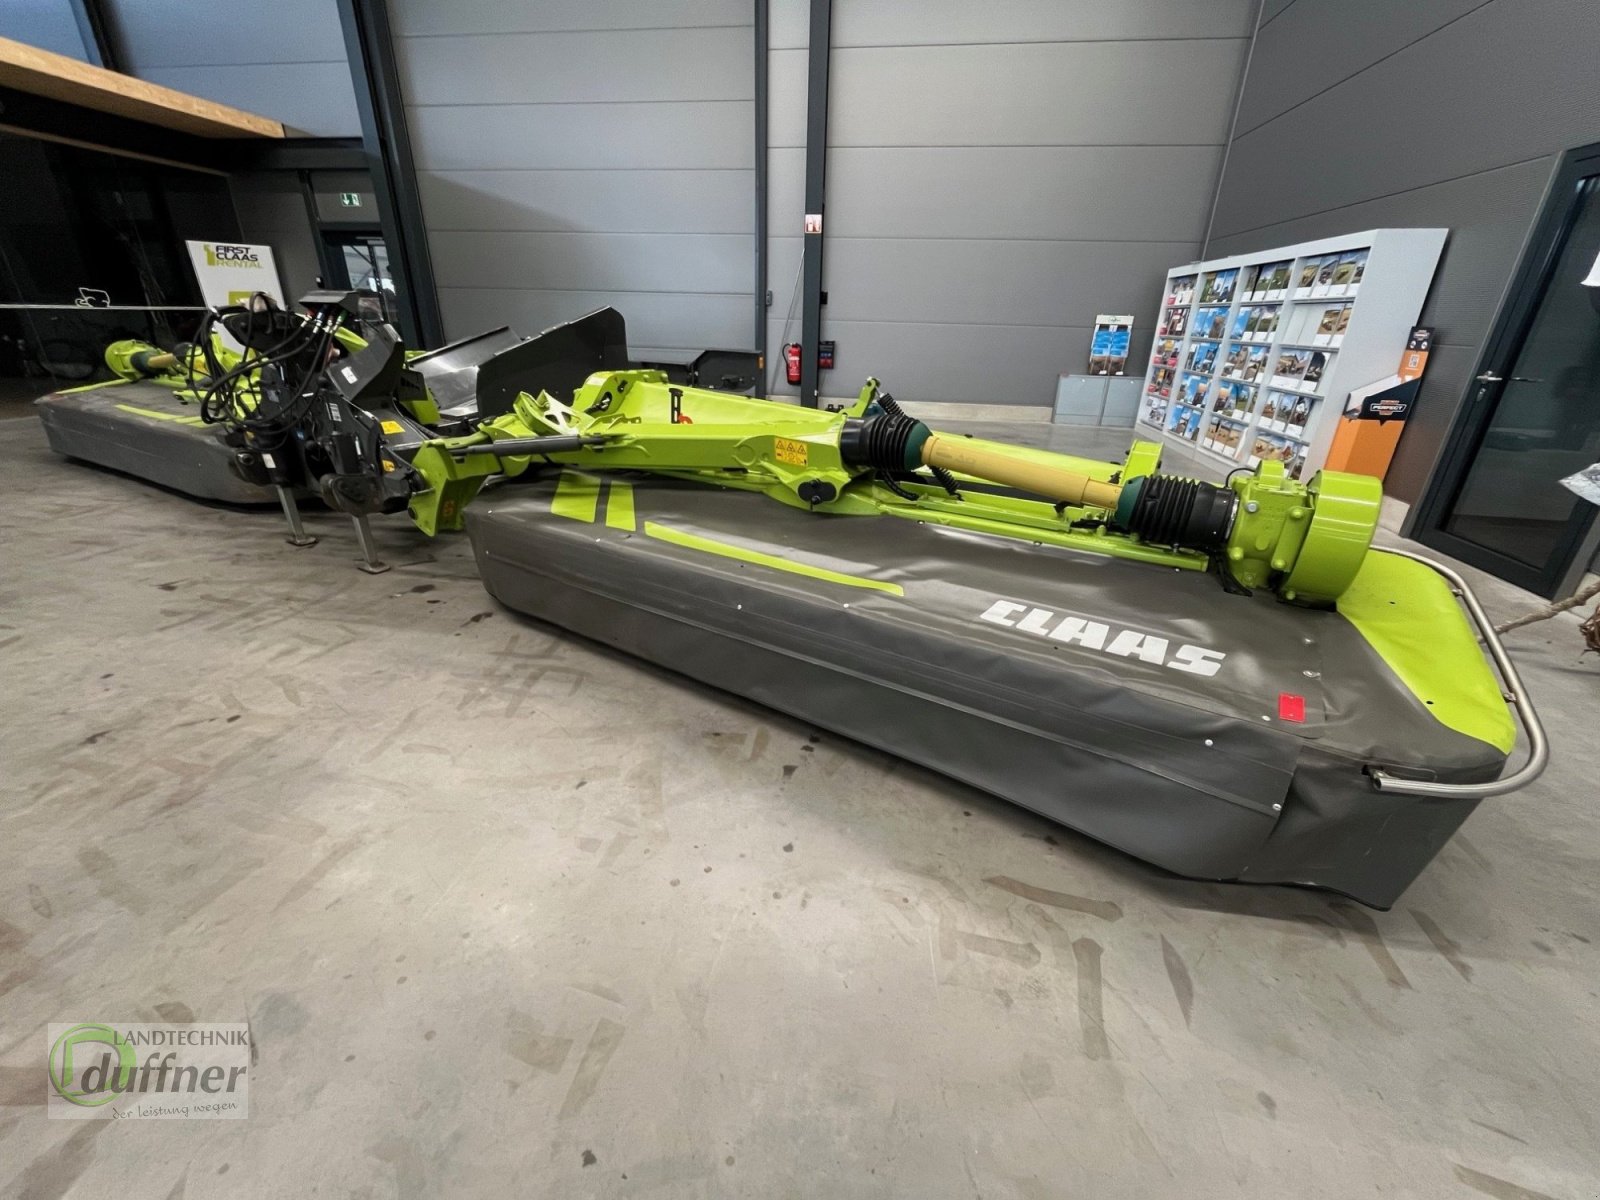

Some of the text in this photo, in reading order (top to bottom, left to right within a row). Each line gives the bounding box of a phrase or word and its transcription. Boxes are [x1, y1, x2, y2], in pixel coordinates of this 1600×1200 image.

[216, 246, 251, 254] FIRST
[216, 253, 258, 262] CLAAS
[216, 260, 263, 268] RENTAL
[980, 600, 1226, 676] CLAAS
